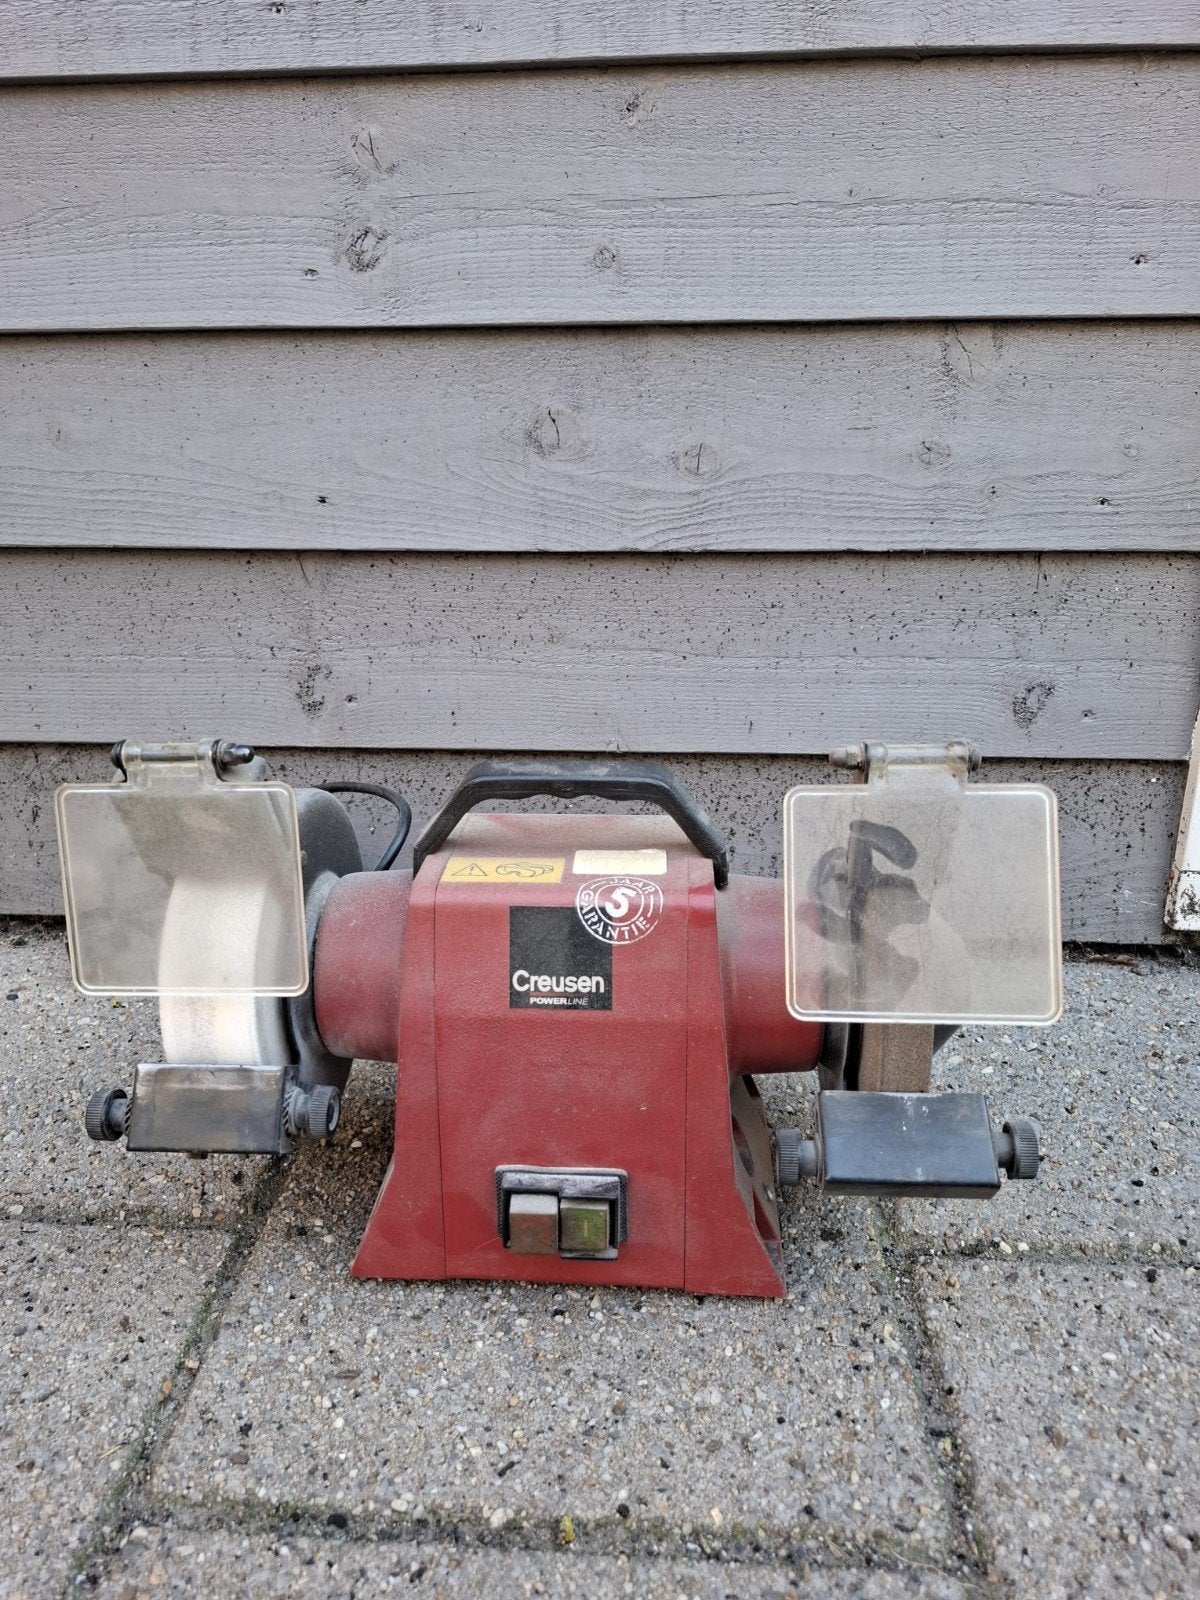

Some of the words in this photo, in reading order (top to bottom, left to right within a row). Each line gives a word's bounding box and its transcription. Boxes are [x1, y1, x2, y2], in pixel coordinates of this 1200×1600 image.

[581, 889, 651, 940] GARANTIE
[605, 887, 637, 918] 5
[512, 969, 605, 993] Creusen
[529, 996, 589, 1005] POWERLINE
